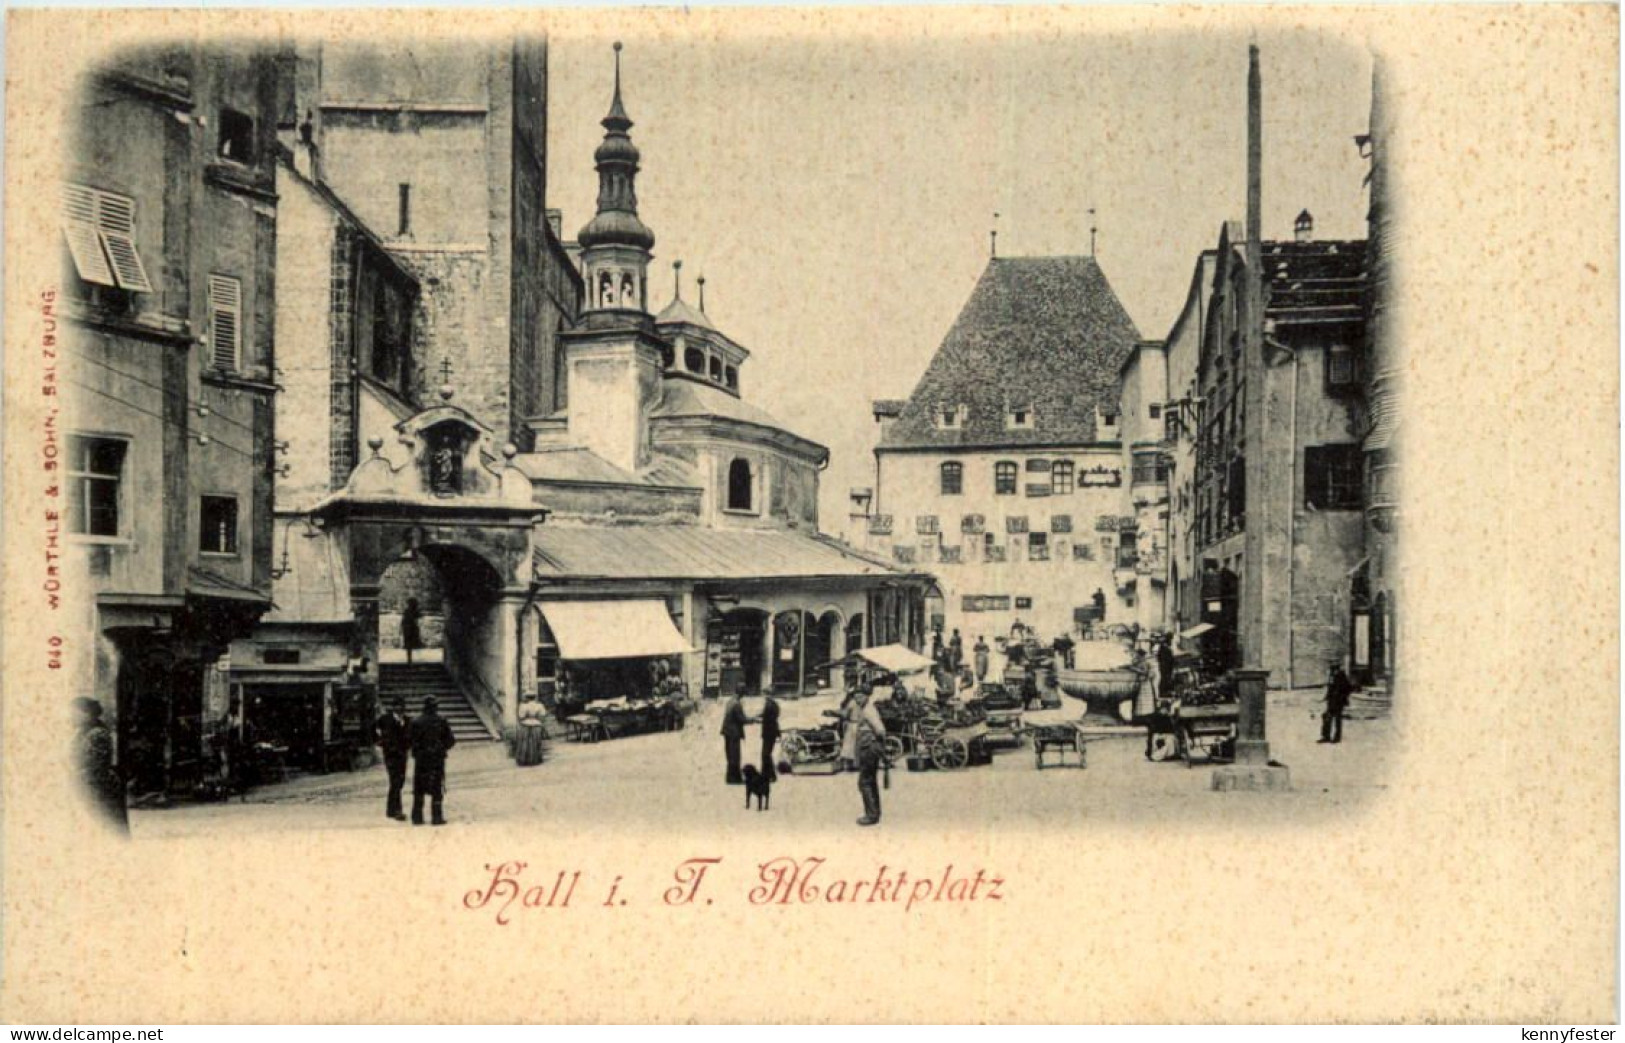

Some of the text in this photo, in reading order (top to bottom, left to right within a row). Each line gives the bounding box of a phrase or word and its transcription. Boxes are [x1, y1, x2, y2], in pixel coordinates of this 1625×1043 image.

[43, 408, 58, 471] SOHN,
[45, 485, 58, 497] &
[43, 509, 60, 610] WÜRTHLE
[463, 861, 581, 925] Hall
[603, 875, 627, 907] i.
[748, 856, 1005, 912] Marktplatz
